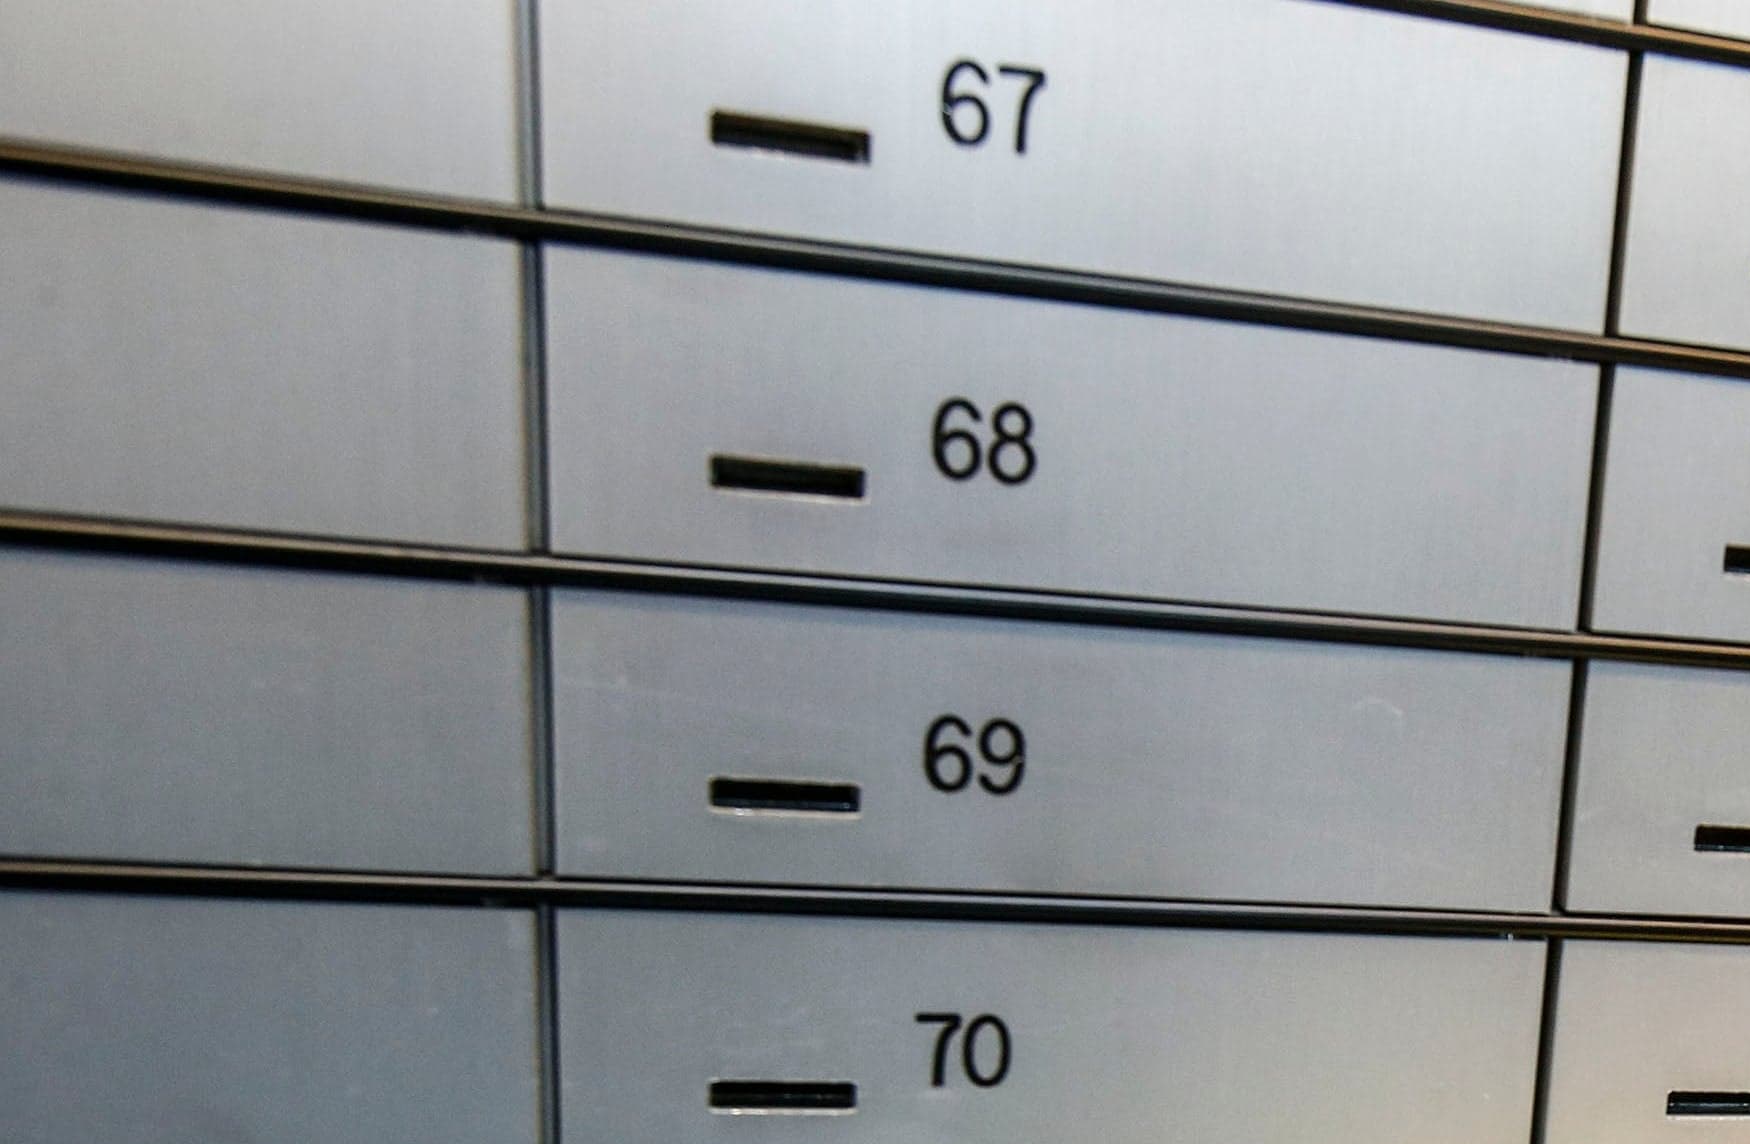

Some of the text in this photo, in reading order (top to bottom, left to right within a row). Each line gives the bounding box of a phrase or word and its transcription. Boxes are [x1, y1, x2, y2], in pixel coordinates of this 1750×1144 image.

[941, 59, 1046, 155] 67
[931, 397, 1037, 487] 68
[923, 714, 1026, 797] 69
[915, 1012, 1012, 1088] 70
